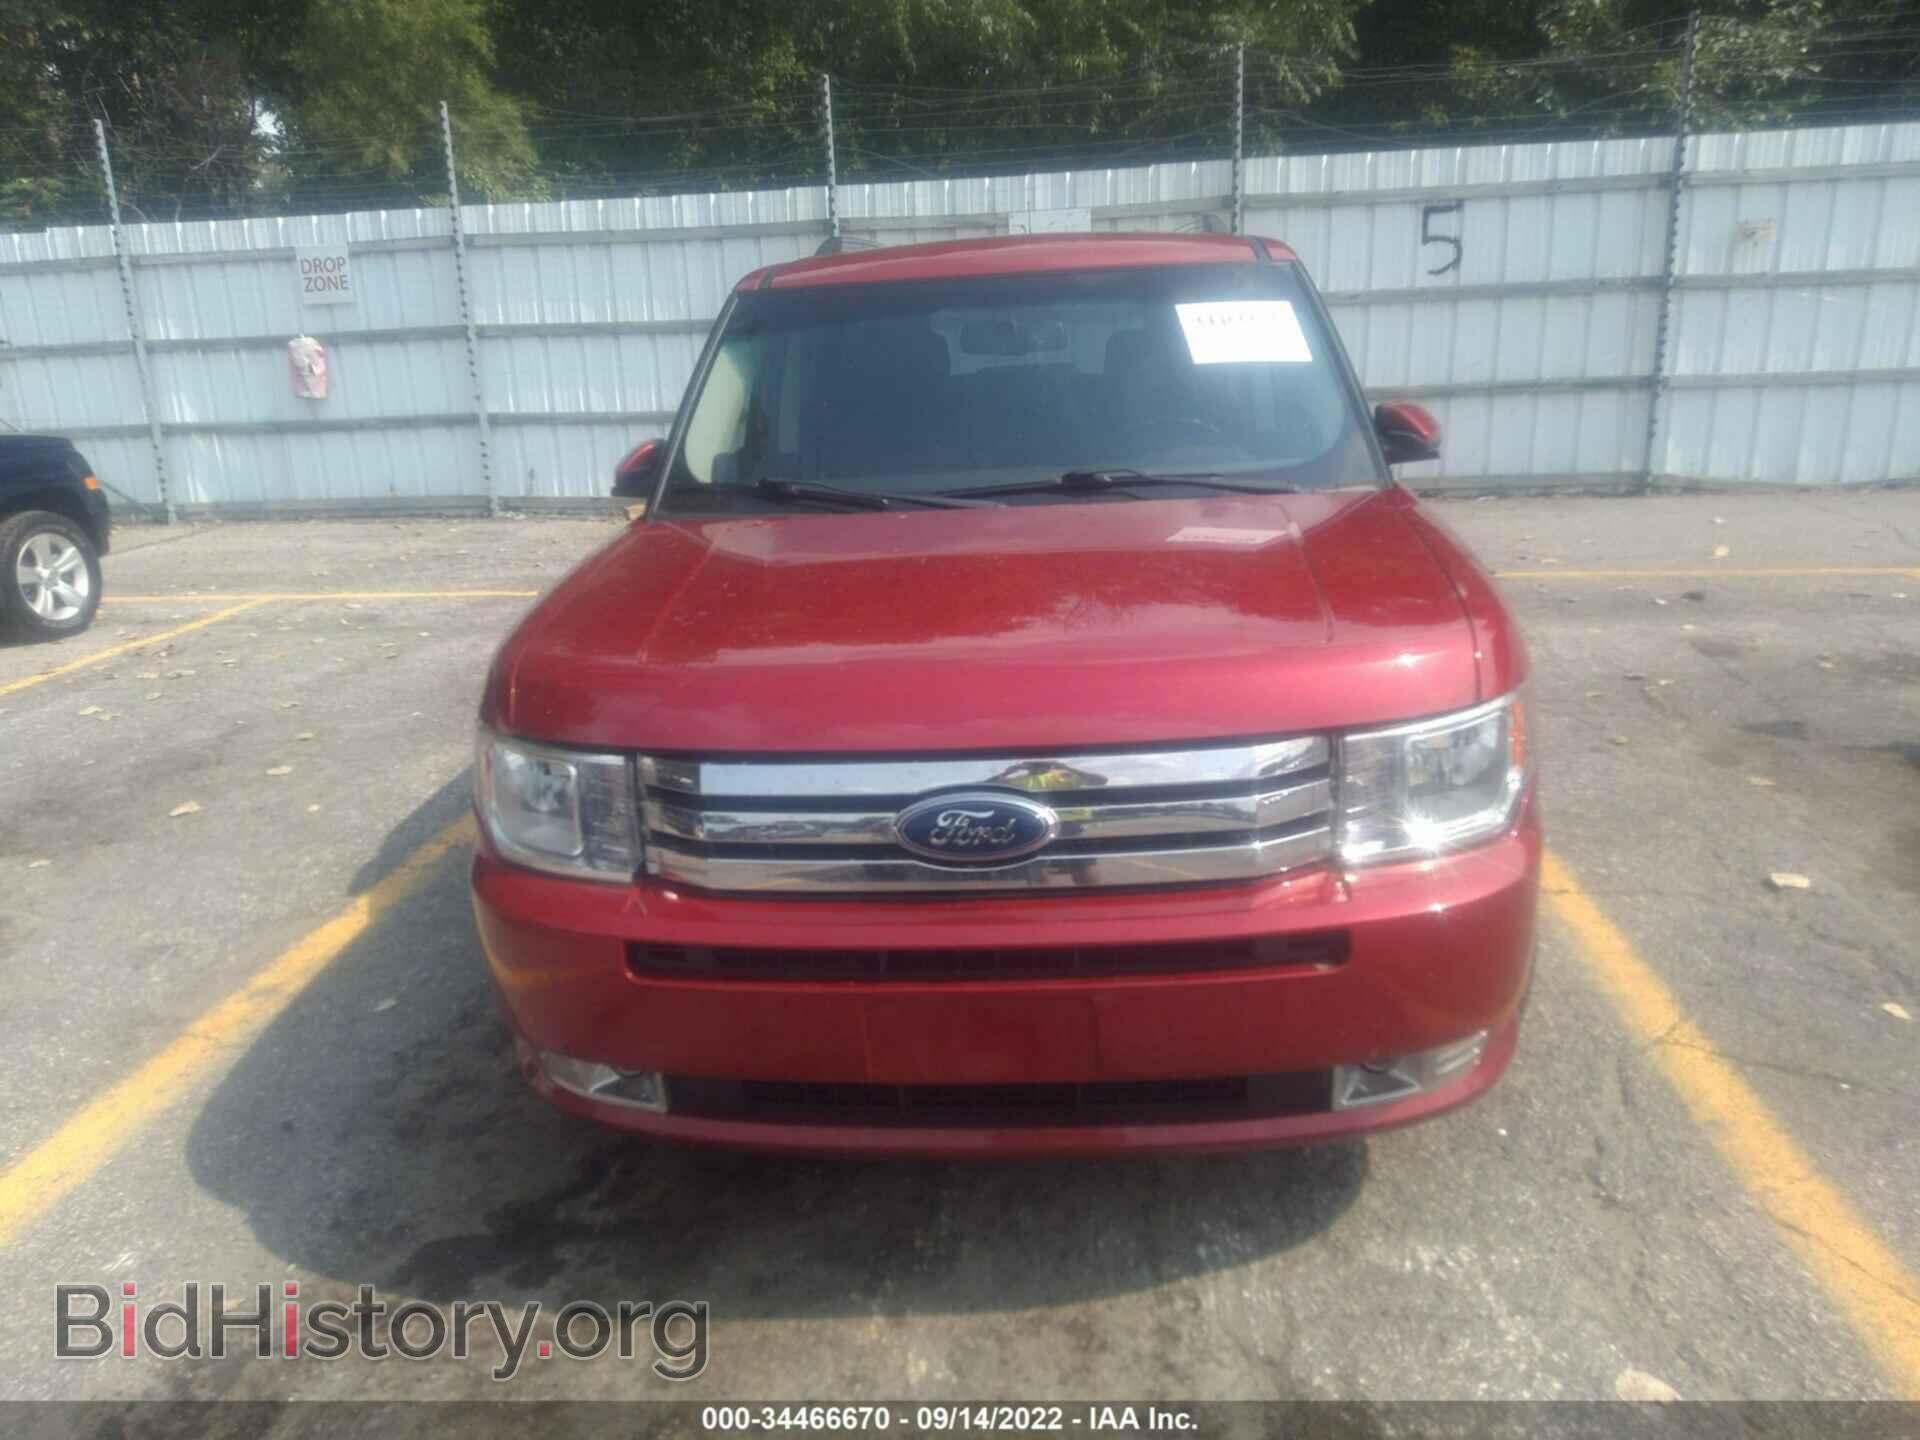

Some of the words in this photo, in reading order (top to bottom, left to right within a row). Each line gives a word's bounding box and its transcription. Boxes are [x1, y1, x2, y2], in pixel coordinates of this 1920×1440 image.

[1421, 202, 1463, 276] 5
[300, 256, 345, 274] DROP
[303, 274, 350, 292] ZONE
[929, 809, 1016, 845] Ford
